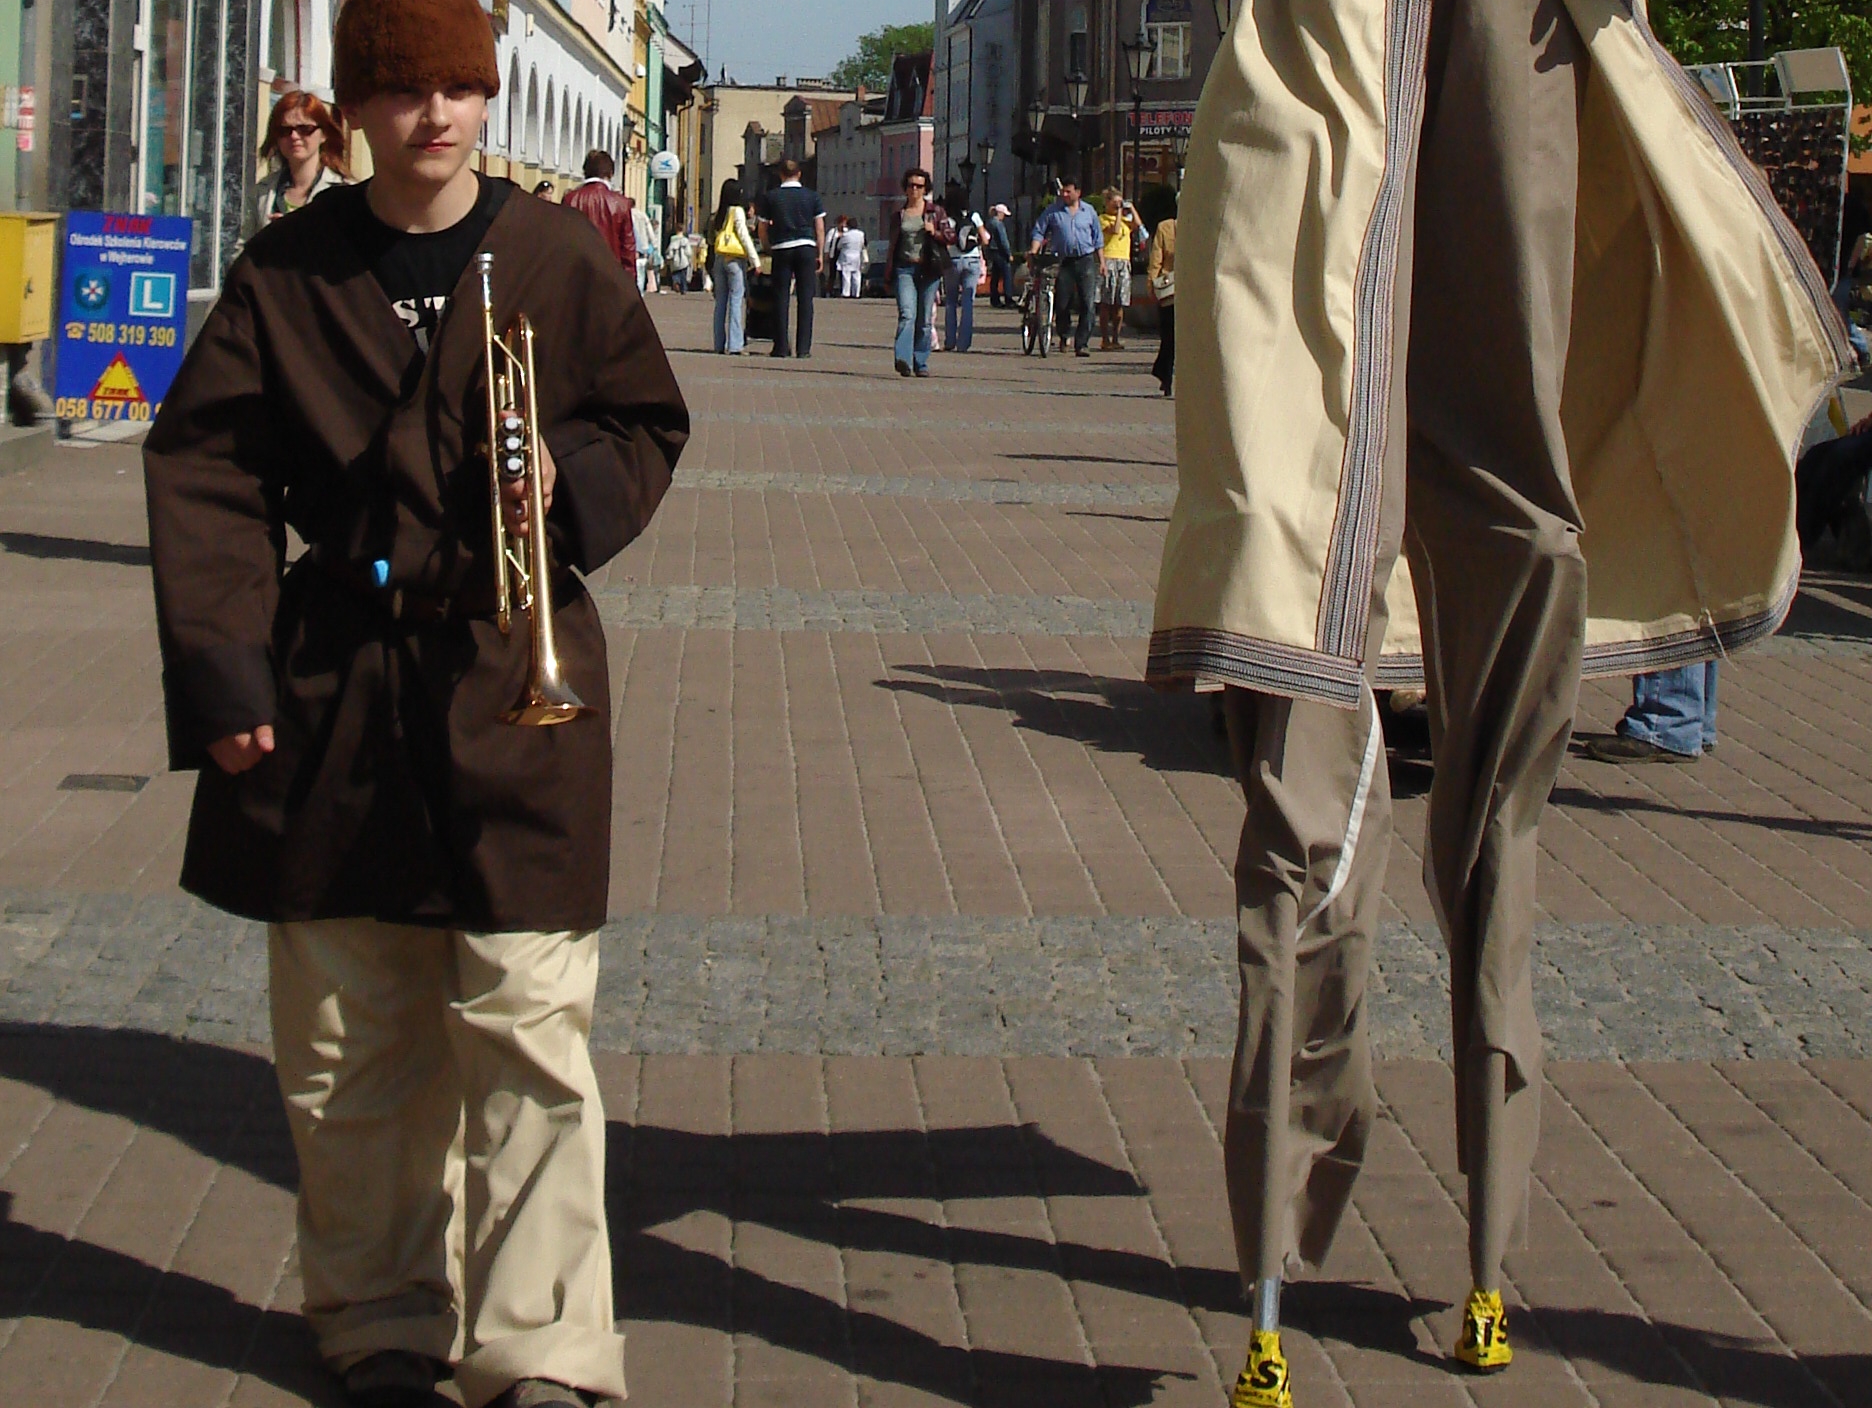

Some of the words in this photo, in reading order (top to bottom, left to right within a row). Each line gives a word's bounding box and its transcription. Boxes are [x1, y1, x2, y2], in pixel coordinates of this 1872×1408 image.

[103, 215, 154, 235] ZNAK
[142, 279, 163, 310] L
[87, 322, 115, 343] 508
[118, 324, 146, 345] 319
[147, 326, 176, 347] 390
[55, 397, 88, 419] 058
[92, 399, 124, 420] 677
[128, 401, 150, 421] 00
